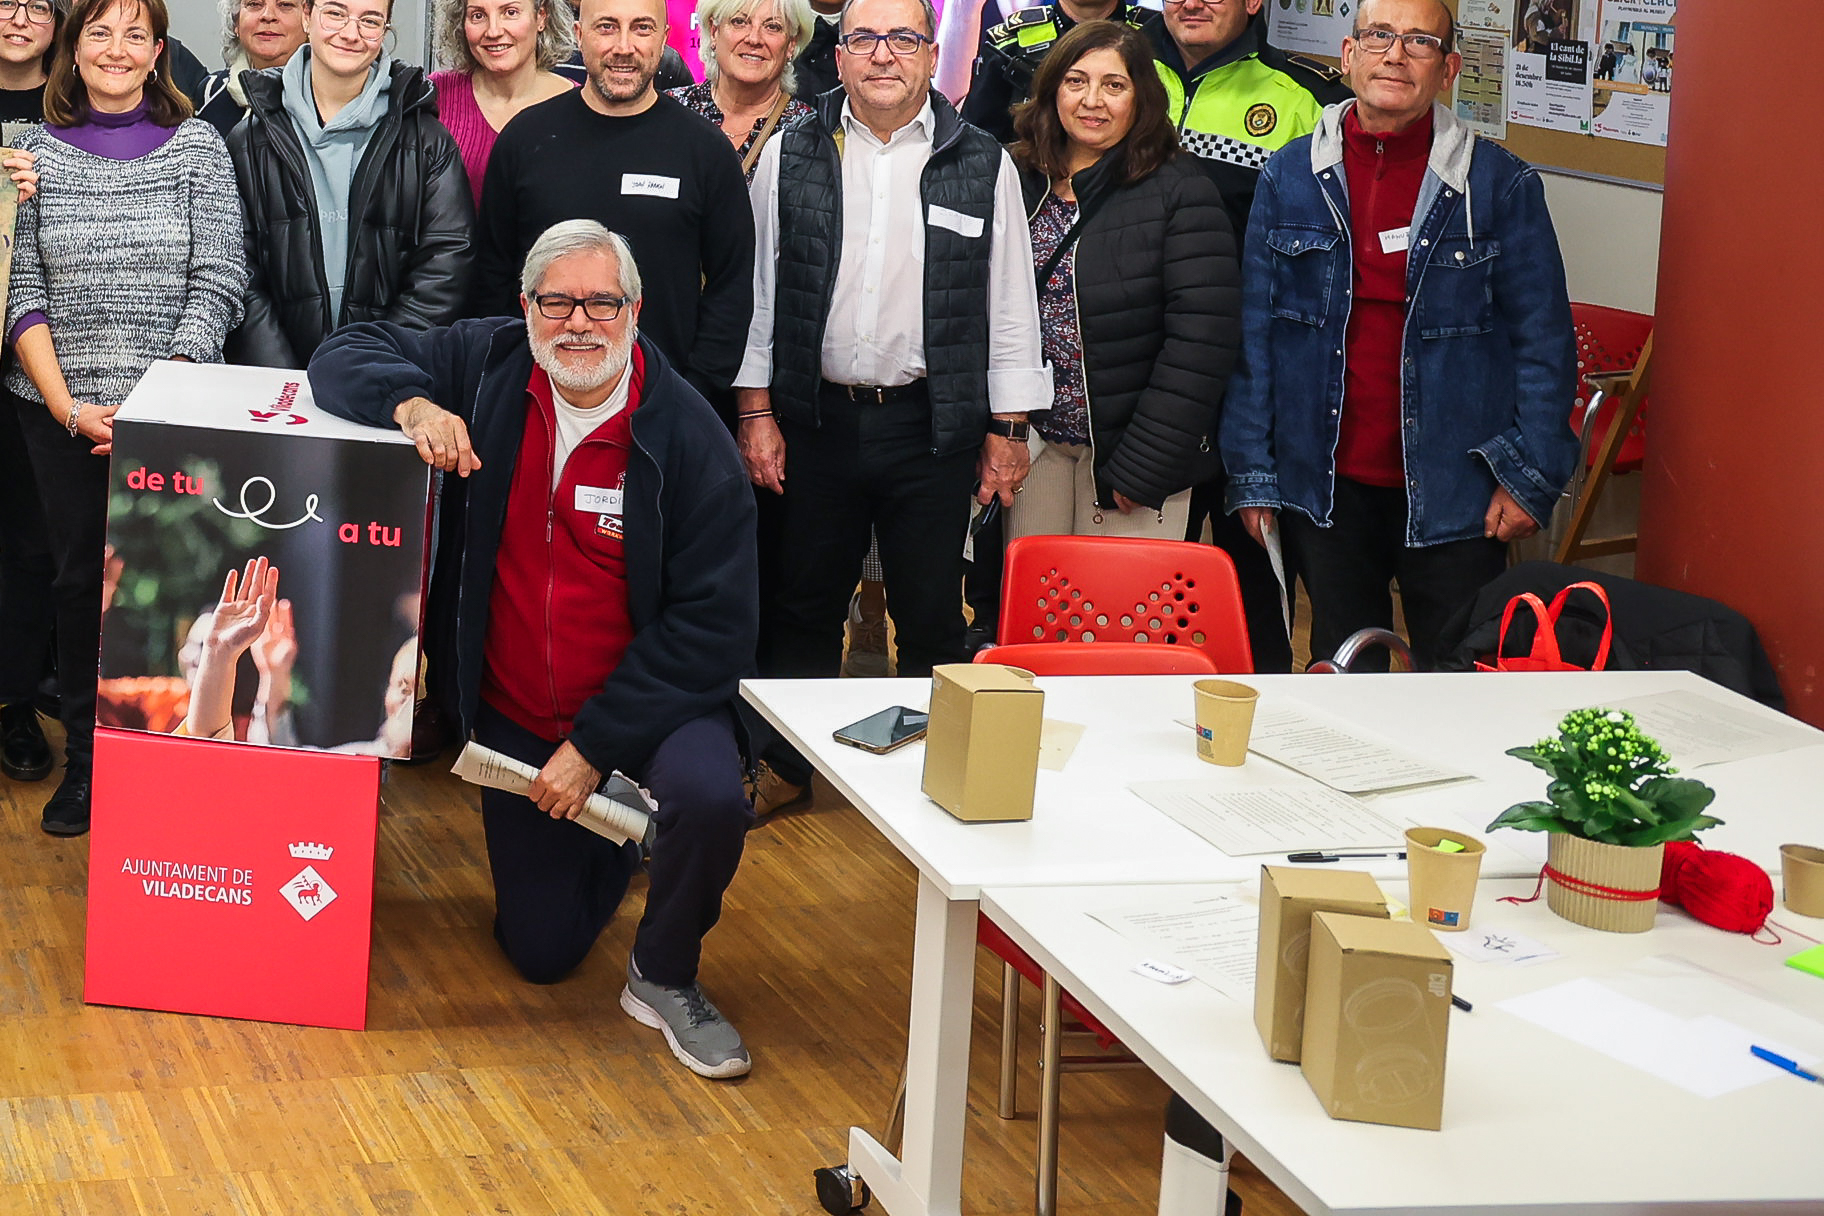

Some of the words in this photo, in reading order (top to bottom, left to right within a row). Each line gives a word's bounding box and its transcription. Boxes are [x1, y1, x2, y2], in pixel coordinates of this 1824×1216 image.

[1549, 52, 1557, 61] la
[1550, 42, 1558, 51] El
[1559, 45, 1575, 53] cant
[1575, 45, 1585, 54] de
[1515, 71, 1543, 82] desembre
[127, 466, 165, 492] de
[173, 471, 204, 496] tu
[584, 493, 622, 505] JORDI
[338, 521, 359, 544] a
[368, 521, 402, 547] tu
[121, 857, 228, 884] AJUNTAMENT
[232, 869, 254, 886] DE
[142, 879, 253, 906] VILADECANS
